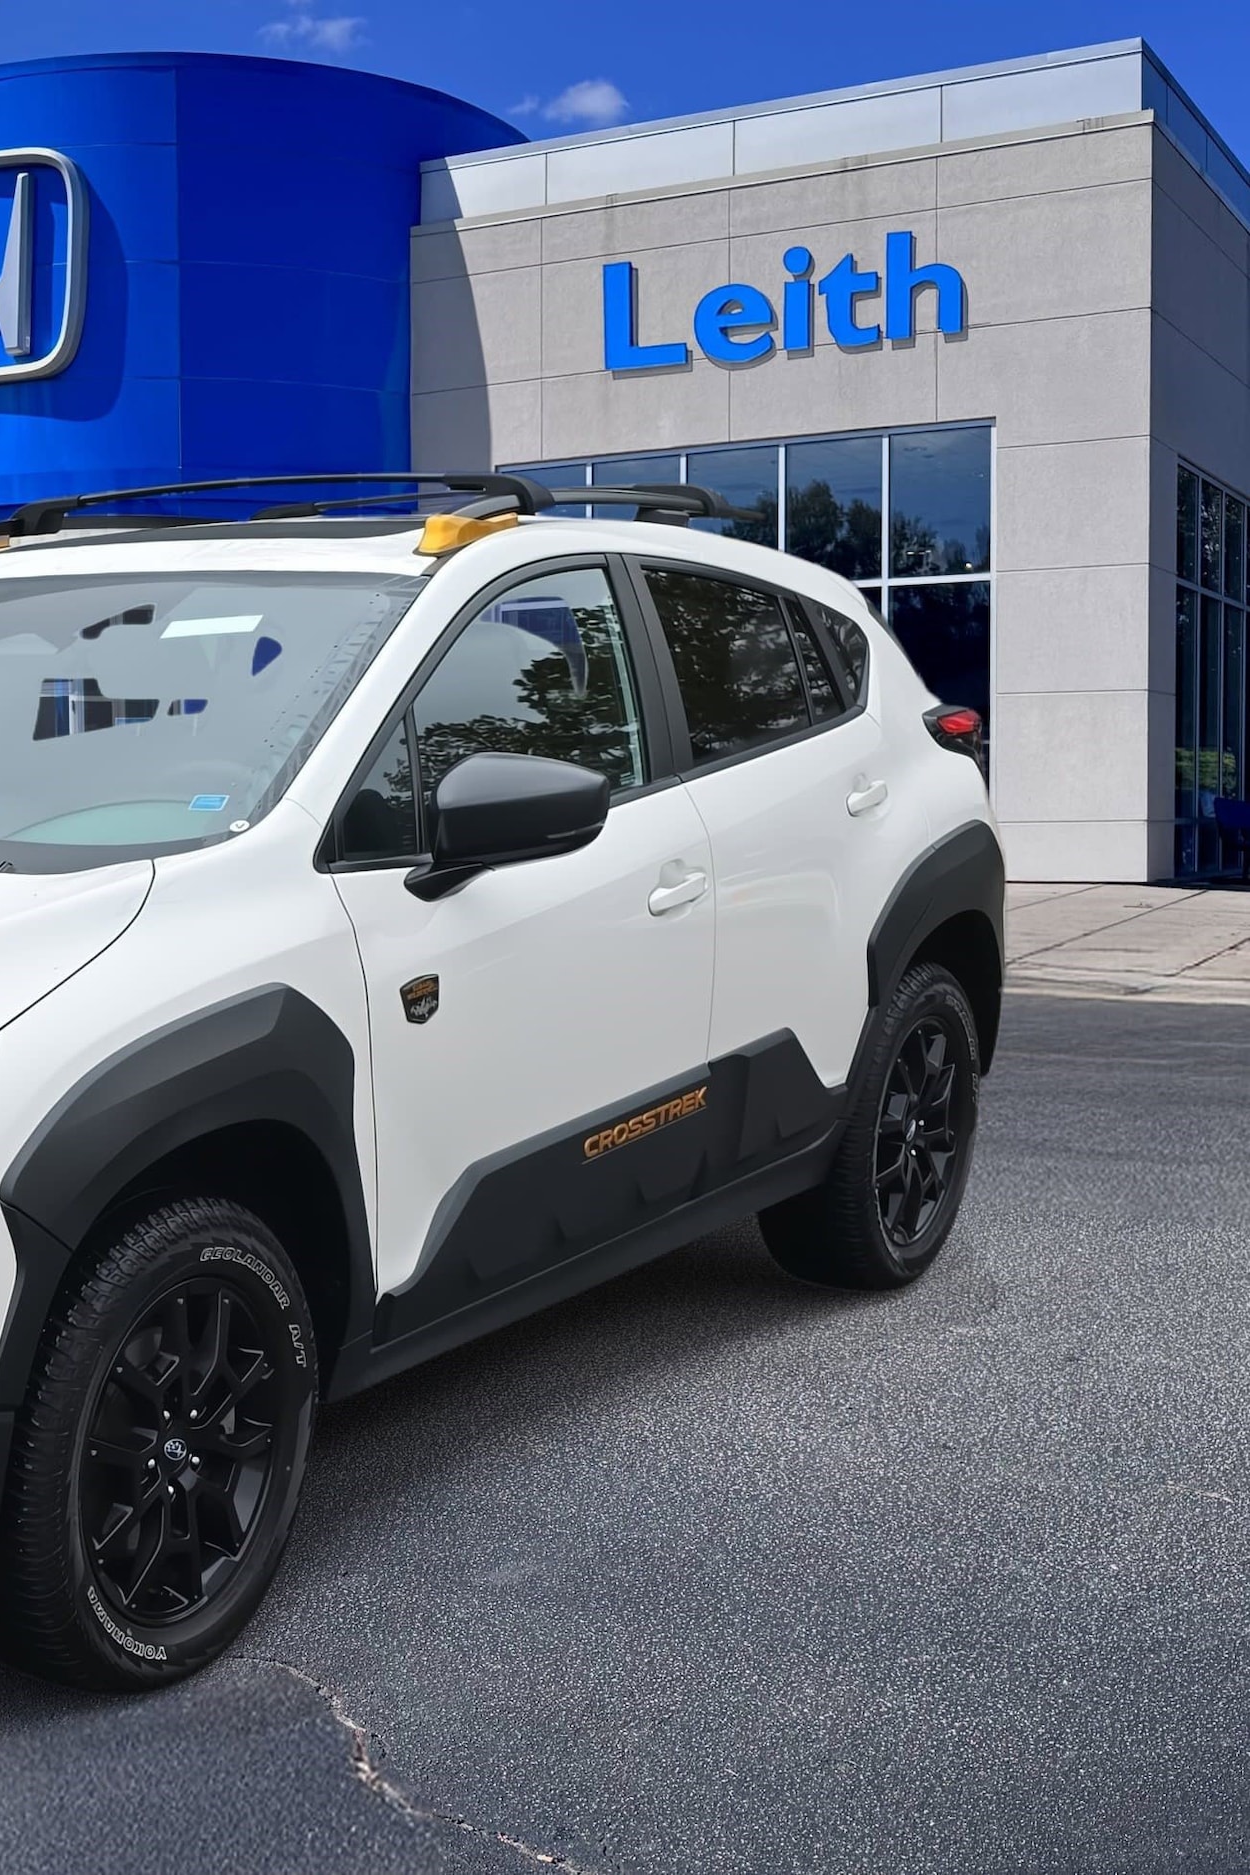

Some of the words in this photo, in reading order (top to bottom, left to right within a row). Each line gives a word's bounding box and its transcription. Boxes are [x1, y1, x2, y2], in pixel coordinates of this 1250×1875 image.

[602, 230, 966, 371] Leith
[583, 1085, 708, 1159] CROSSTREK
[199, 1246, 291, 1310] GEOLANDAR
[288, 1323, 308, 1369] A/T
[86, 1585, 168, 1661] YOKOHAMA
